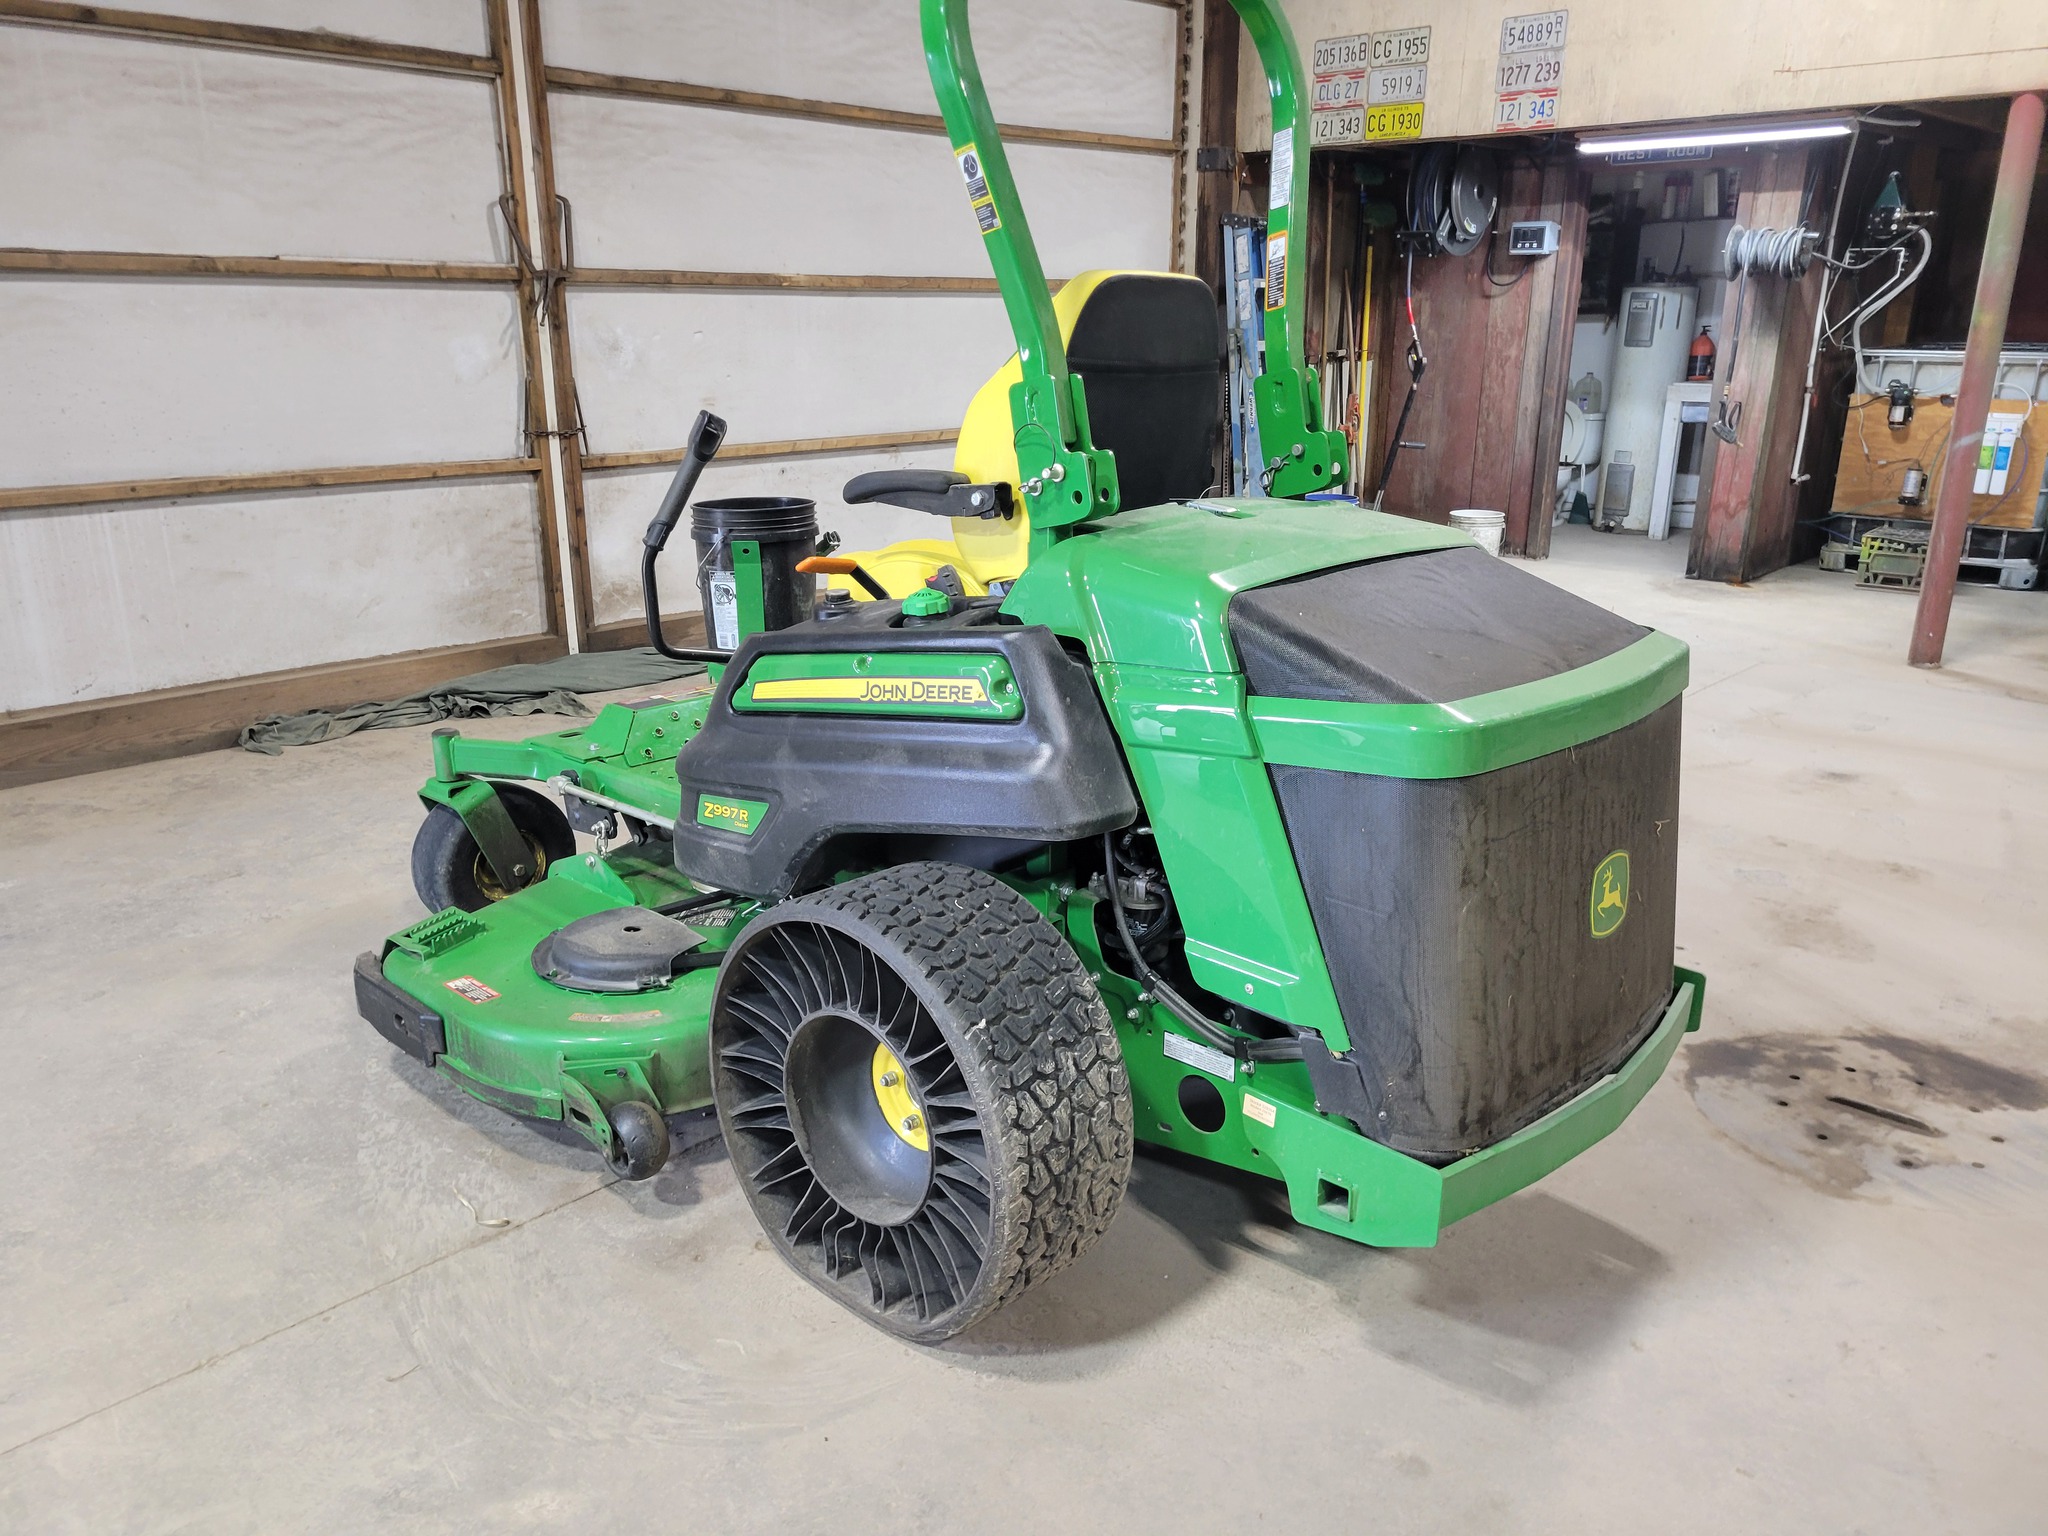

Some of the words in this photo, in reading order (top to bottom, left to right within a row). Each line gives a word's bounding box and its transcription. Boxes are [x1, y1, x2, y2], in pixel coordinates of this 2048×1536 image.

[1508, 22, 1553, 46] 54889
[1373, 39, 1393, 60] CG
[1398, 36, 1428, 57] 1955
[1501, 64, 1531, 87] 1277
[1535, 61, 1561, 83] 239
[1319, 83, 1341, 102] CLG
[1344, 80, 1360, 99] 27
[1382, 75, 1413, 96] 5919
[1501, 101, 1522, 122] 121
[1529, 98, 1555, 119] 343
[1315, 119, 1334, 138] 121
[1338, 117, 1360, 136] 343
[1367, 114, 1387, 133] CG
[1391, 113, 1420, 131] 1930
[704, 801, 749, 822] Z997R
